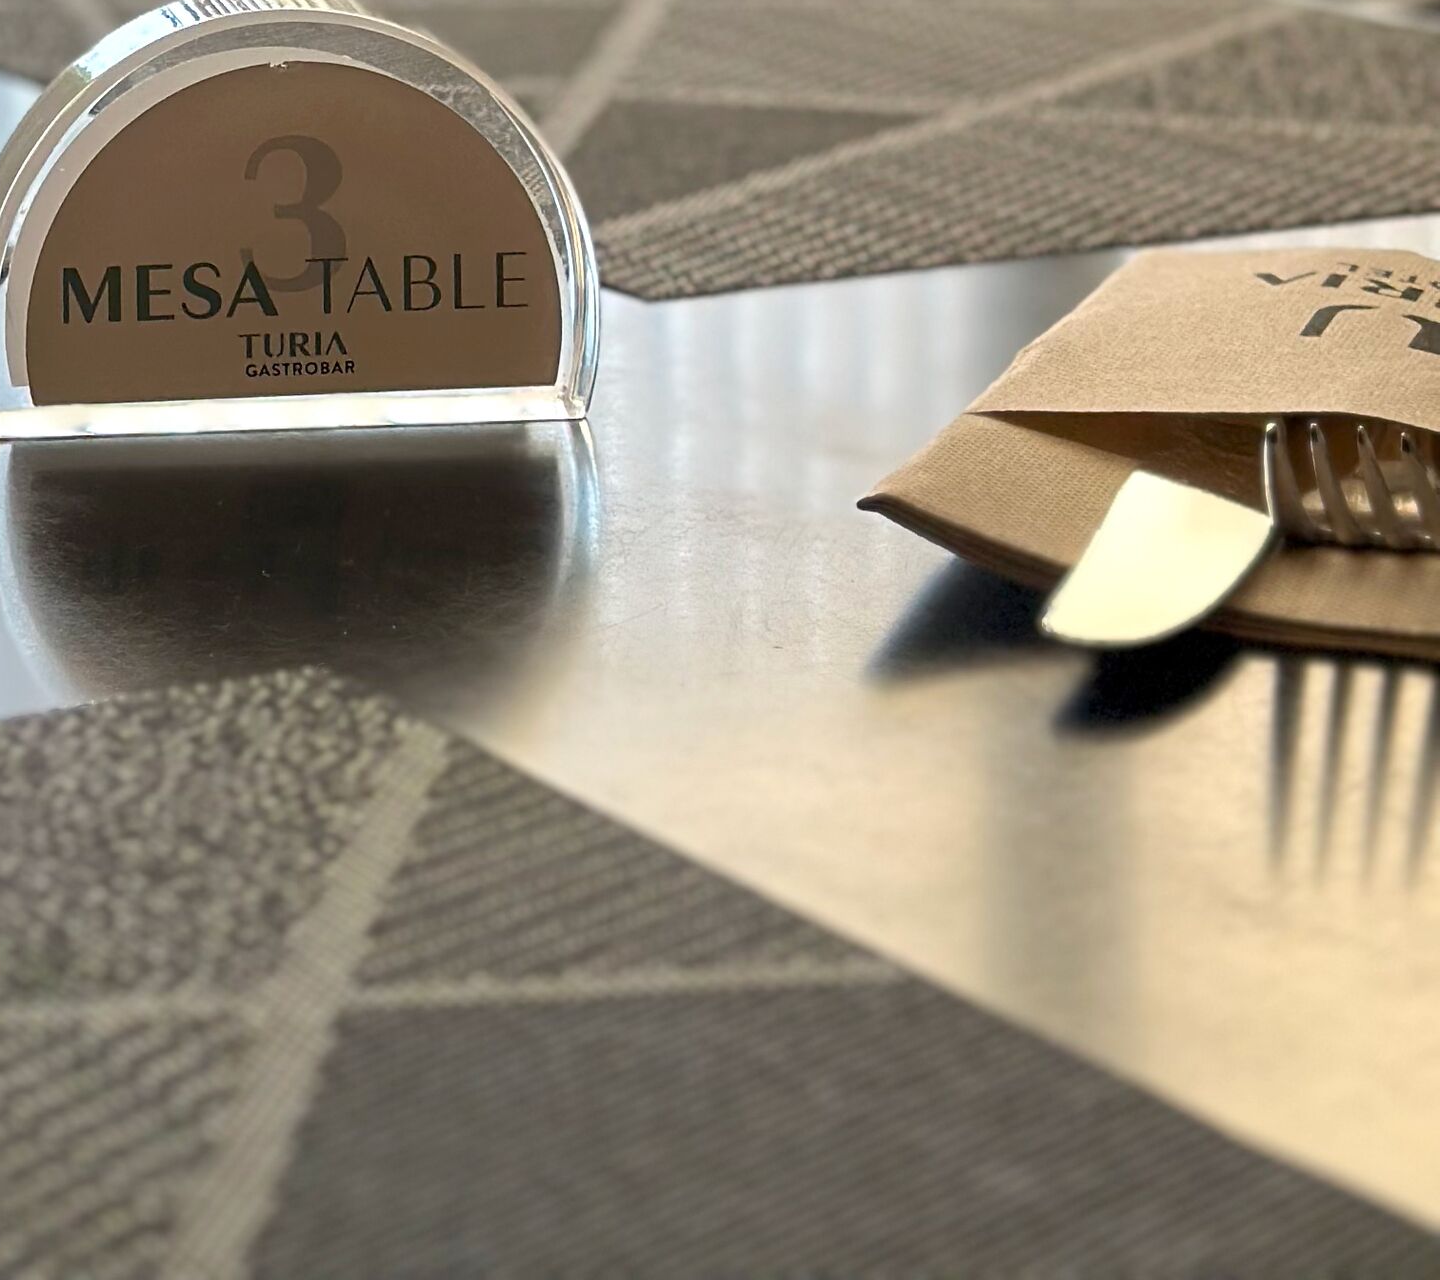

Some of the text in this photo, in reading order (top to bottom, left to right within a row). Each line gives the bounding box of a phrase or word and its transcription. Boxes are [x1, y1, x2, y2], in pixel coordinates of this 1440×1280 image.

[239, 134, 347, 293] 3
[61, 250, 529, 325] MESA TABLE
[1253, 270, 1440, 309] RIA
[237, 330, 348, 359] TURIA
[245, 359, 356, 378] GASTROBAR
